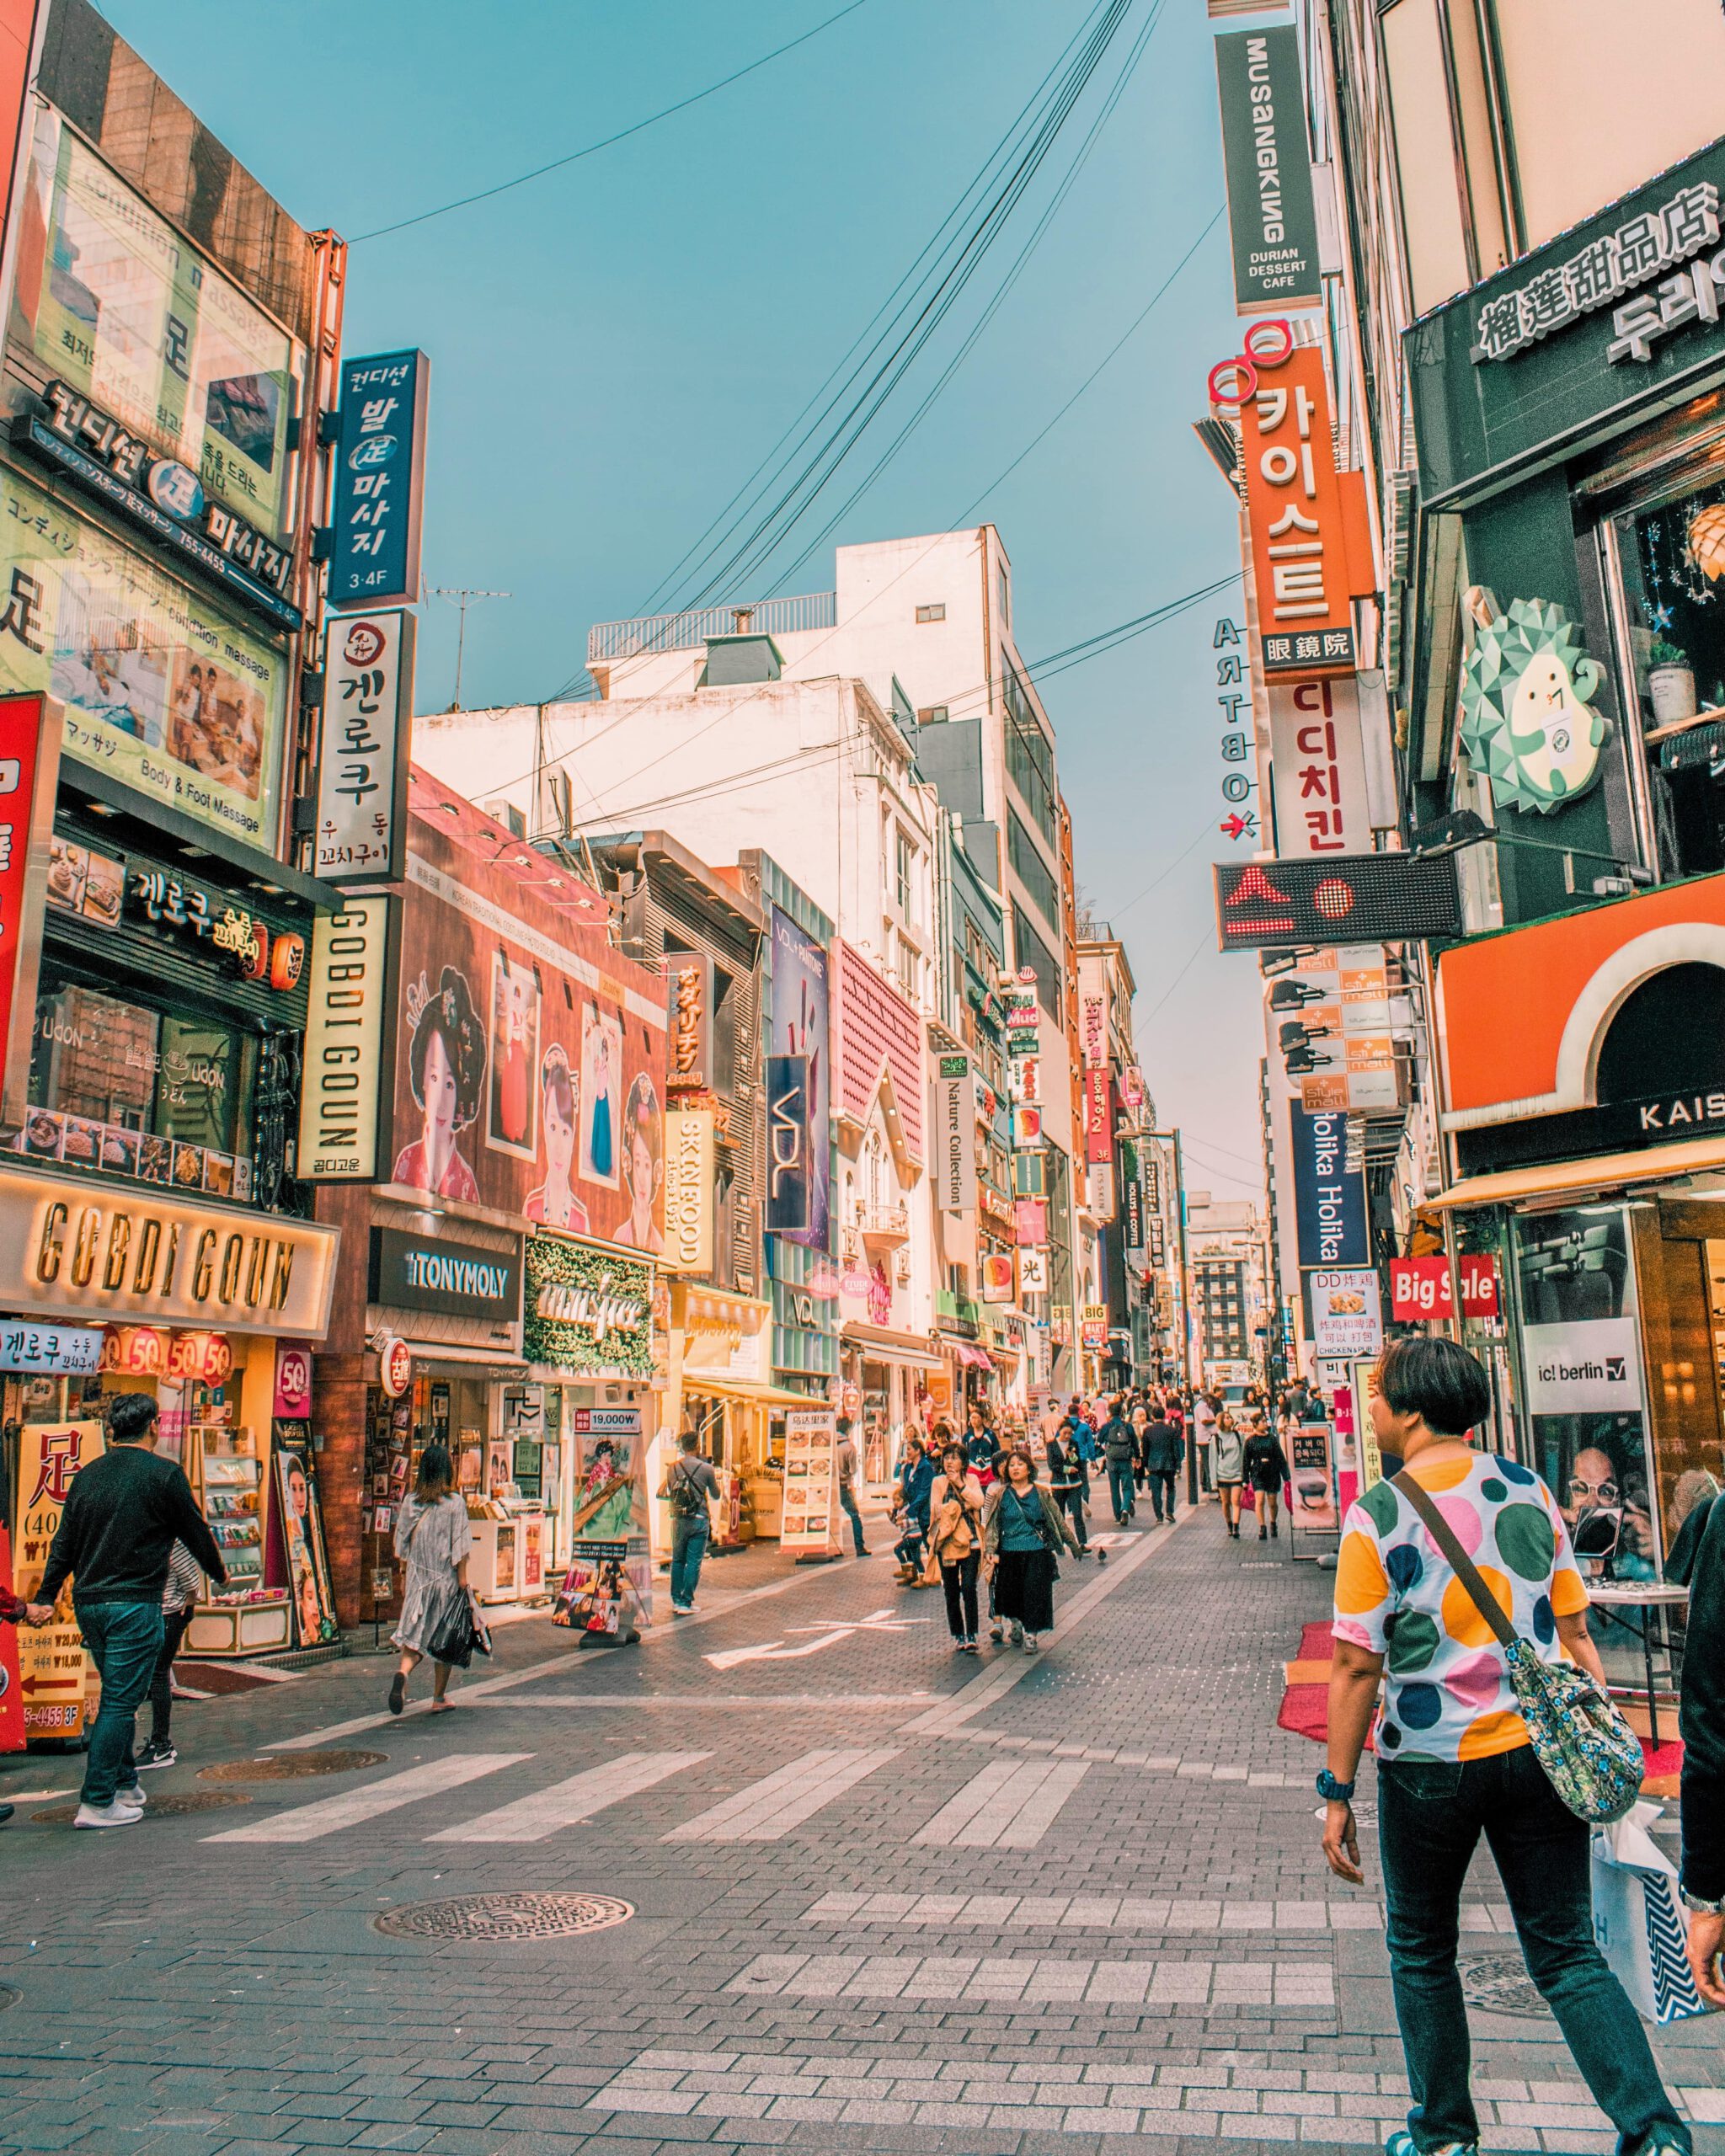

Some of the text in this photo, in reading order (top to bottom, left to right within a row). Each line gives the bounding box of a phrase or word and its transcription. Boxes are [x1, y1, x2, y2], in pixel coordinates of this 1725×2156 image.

[1248, 260, 1306, 277] DESSERT
[1250, 248, 1299, 264] DURIAN
[1263, 275, 1295, 289] CAFE
[350, 364, 409, 392] 컨디션
[360, 398, 399, 433] 발
[48, 383, 293, 591] 컨디션 足 마사지
[1255, 384, 1330, 621] 카이스트
[350, 472, 390, 556] 마사지
[179, 531, 226, 574] 755-4455
[225, 641, 270, 681] massage
[1267, 632, 1350, 662] 眼鏡院
[335, 670, 385, 805] 겐로쿠
[1293, 680, 1345, 851] 디디치킨
[141, 758, 173, 790] Body
[185, 783, 213, 809] Foot
[214, 800, 259, 834] Massage
[318, 843, 388, 865] 꼬치구이
[136, 873, 211, 937] 겐로쿠
[776, 921, 793, 951] VDL
[319, 910, 367, 1148] GOBDI GOUN
[1007, 1011, 1039, 1025] Mud
[772, 1086, 800, 1199] VDL
[948, 1082, 963, 1204] Nature Collection
[1092, 1119, 1102, 1134] 2
[313, 1157, 360, 1173] 곱디고운
[1097, 1150, 1108, 1160] 3F
[680, 1120, 702, 1263] SKINFOOD
[1129, 1182, 1137, 1210] HOLLYS
[1317, 1186, 1343, 1262] Holika
[36, 1202, 295, 1311] GOBDI GOUN
[1023, 1260, 1041, 1282] 光
[411, 1252, 508, 1299] TONYMOLY
[845, 1279, 868, 1288] ETUDE
[1317, 1274, 1341, 1288] DD
[1396, 1272, 1434, 1310] Big
[792, 1293, 819, 1327] VDL
[1086, 1308, 1103, 1318] BIG
[1085, 1323, 1105, 1335] MART
[1325, 1332, 1372, 1343] 可以 打包
[7, 1331, 61, 1366] 겐로쿠
[61, 1356, 97, 1371] 꼬치구이
[131, 1338, 160, 1371] 50
[170, 1341, 198, 1374] 50
[205, 1342, 231, 1376] 50
[282, 1362, 304, 1392] 50
[1560, 1361, 1604, 1381] berlin
[65, 1705, 78, 1726] 3F
